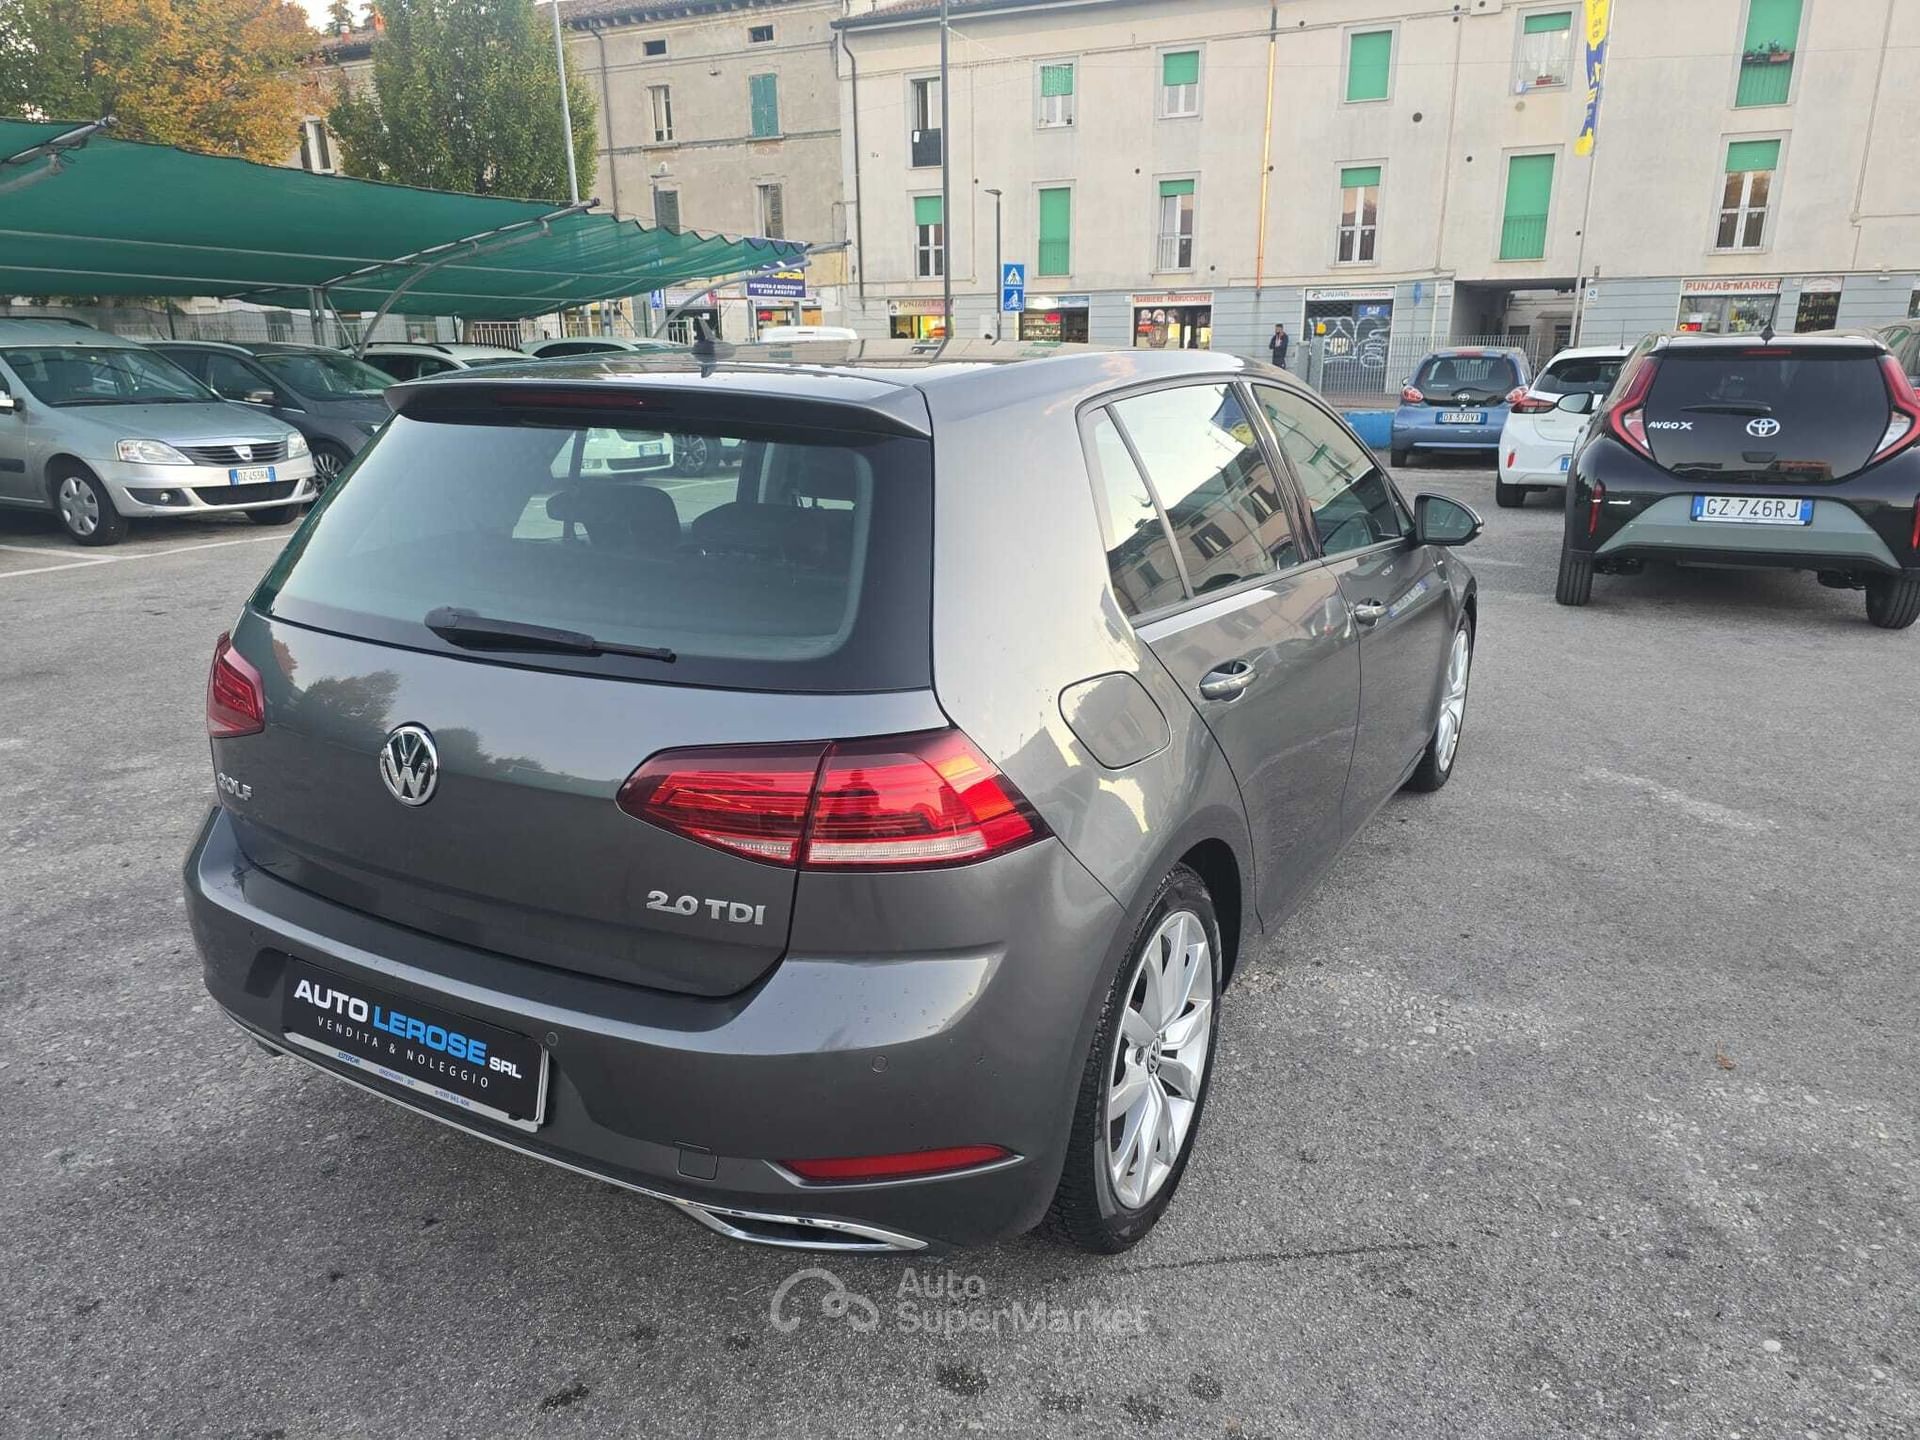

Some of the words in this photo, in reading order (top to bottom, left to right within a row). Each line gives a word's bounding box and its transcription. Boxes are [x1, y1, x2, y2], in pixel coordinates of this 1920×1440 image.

[1685, 281, 1729, 291] PUNJAB
[1733, 280, 1780, 290] MARKET
[1648, 421, 1679, 429] AYGO
[1680, 421, 1693, 430] X
[1706, 498, 1730, 516] GZ
[1737, 498, 1799, 518] 746RJ
[217, 772, 252, 801] GOLF
[704, 898, 766, 925] TDI
[294, 979, 368, 1022] AUTO
[372, 1005, 487, 1066] LEROSE
[489, 1056, 522, 1079] SRL
[317, 1015, 378, 1048] VENDITA
[388, 1043, 396, 1055] &
[406, 1049, 489, 1088] NOLEGGIO
